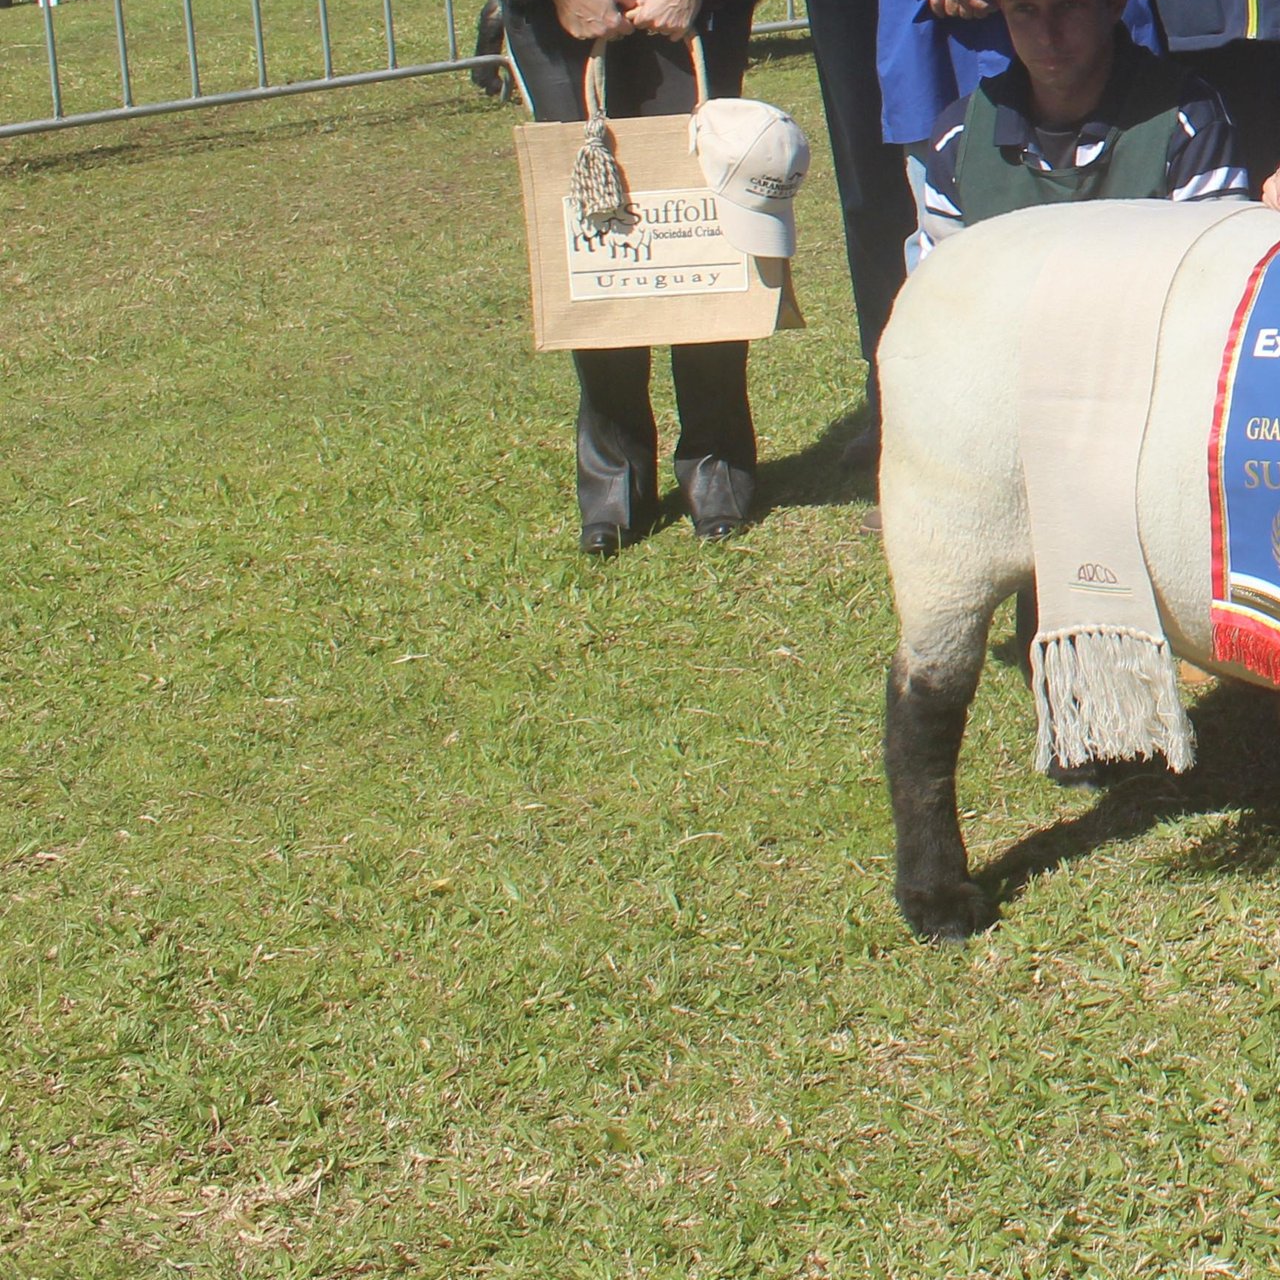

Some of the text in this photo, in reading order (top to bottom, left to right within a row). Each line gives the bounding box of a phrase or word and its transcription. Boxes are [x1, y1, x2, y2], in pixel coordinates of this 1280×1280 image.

[652, 226, 724, 240] Sociedad Criad
[597, 271, 721, 290] Uruguay
